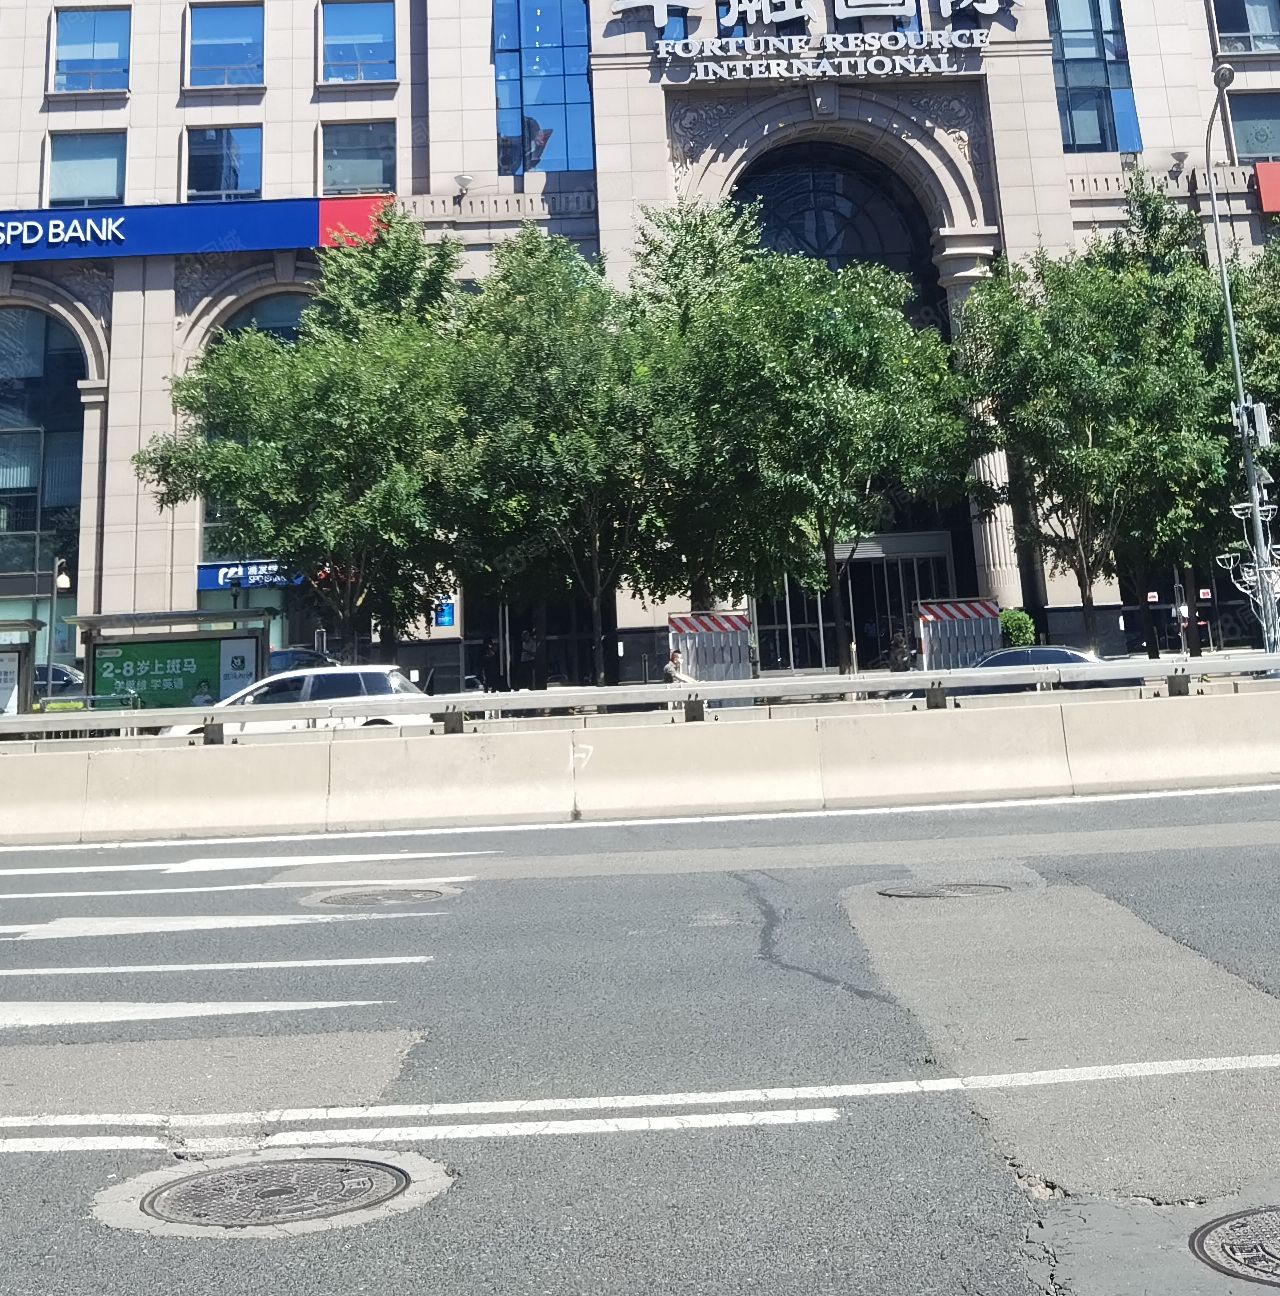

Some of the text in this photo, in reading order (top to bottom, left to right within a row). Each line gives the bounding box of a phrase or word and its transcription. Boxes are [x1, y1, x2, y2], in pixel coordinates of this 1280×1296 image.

[655, 29, 990, 58] FORTUNE RESOURCE
[693, 54, 957, 80] INTERNATIONAL
[47, 217, 126, 243] BANK
[101, 657, 197, 678] 2-8岁上斑马
